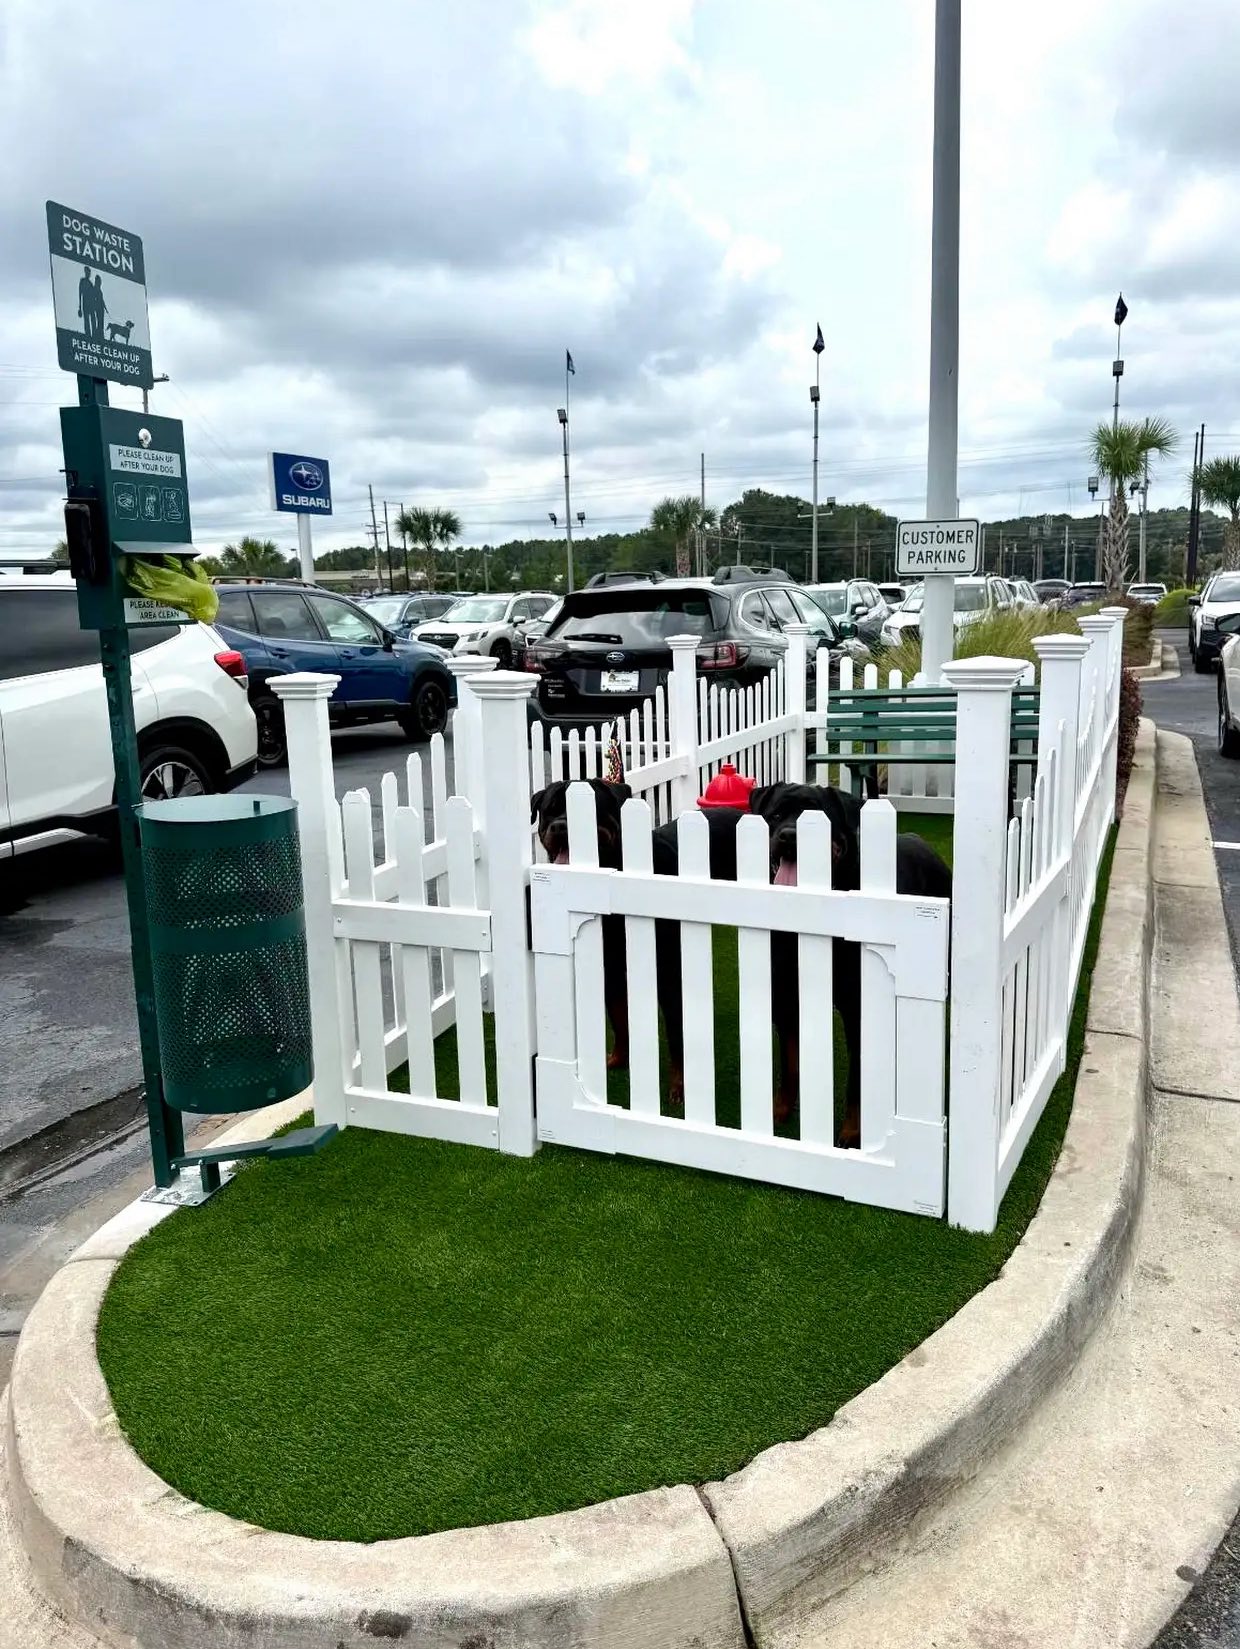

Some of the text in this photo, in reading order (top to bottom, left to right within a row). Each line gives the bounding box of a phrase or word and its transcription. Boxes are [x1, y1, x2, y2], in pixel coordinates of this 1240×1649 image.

[62, 214, 131, 252] DOG WASTE
[62, 233, 134, 273] STATION
[72, 338, 141, 364] PLEASE CLEAN UP
[74, 351, 141, 376] AFTER YOUR DOG
[118, 448, 142, 459] PLEASE
[143, 452, 165, 461] CLEAN
[120, 460, 174, 474] AFTER YOUR DOG
[282, 494, 330, 509] SUBARU
[902, 529, 975, 545] CUSTOMER
[907, 549, 967, 565] PARKING
[129, 600, 154, 609] PLEASE
[140, 611, 180, 620] AREA CLEAN
